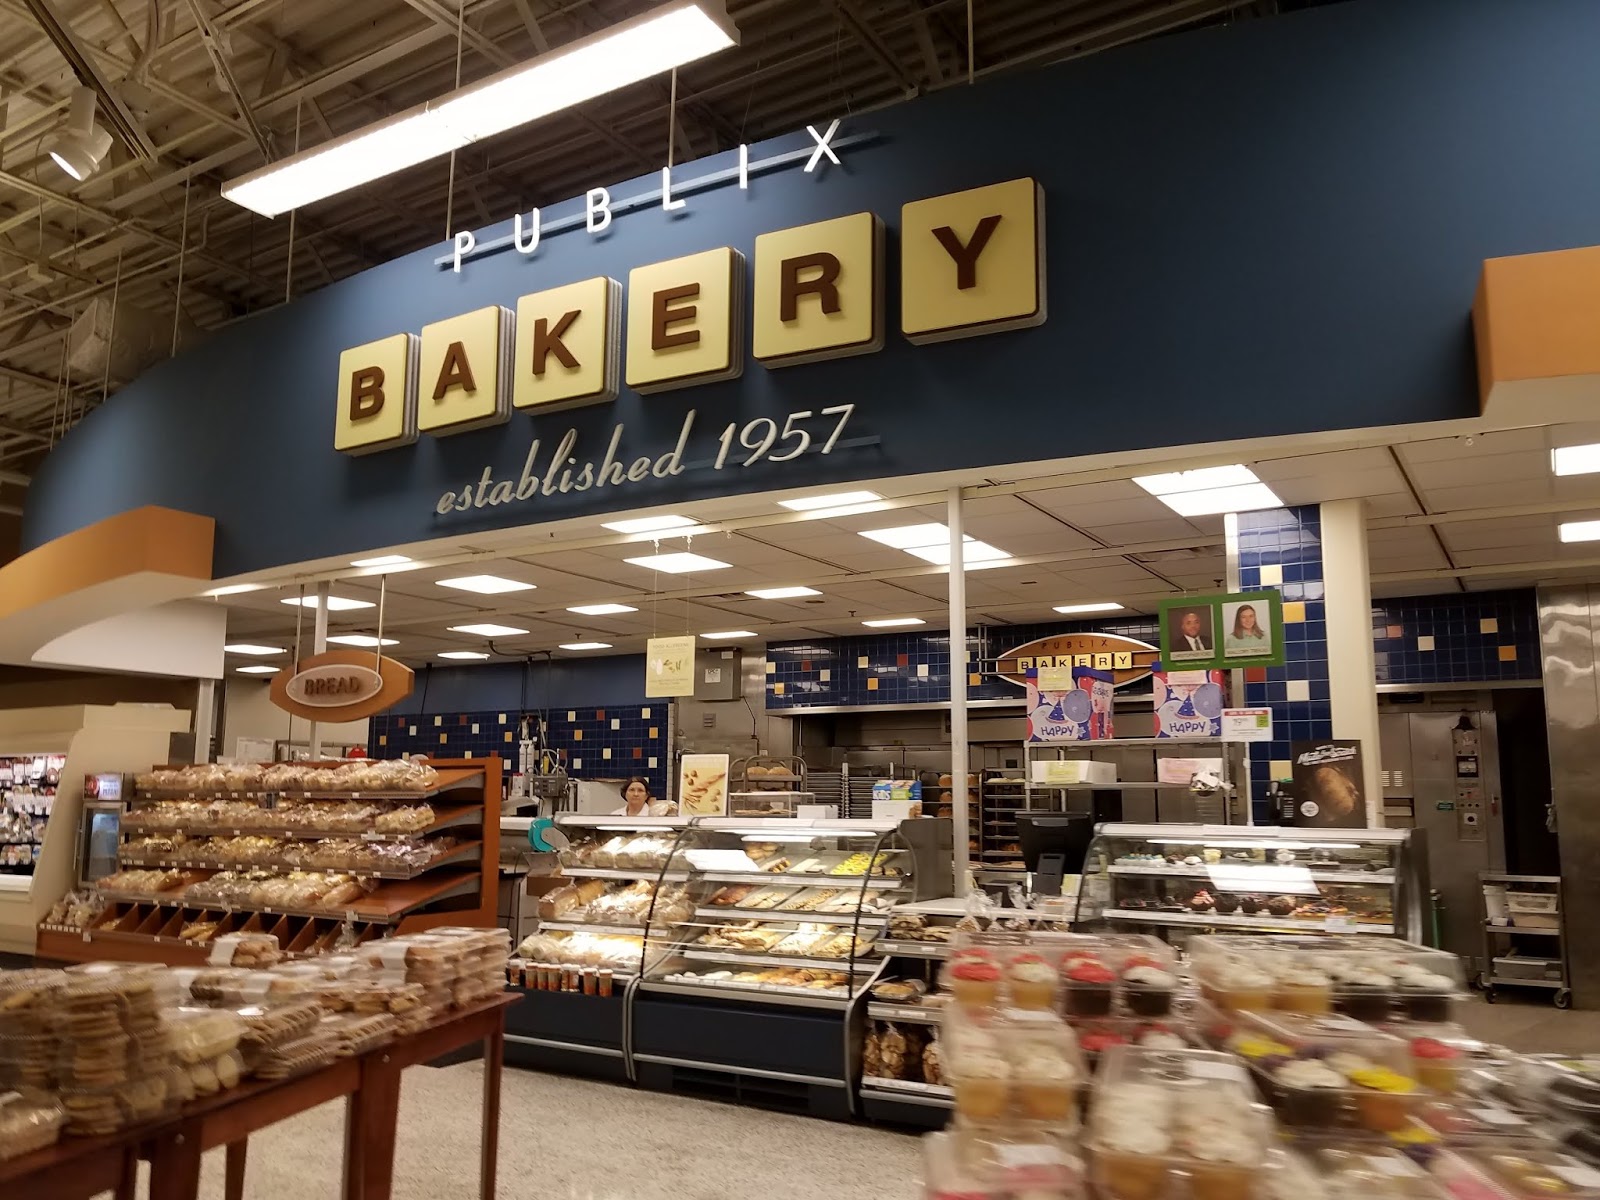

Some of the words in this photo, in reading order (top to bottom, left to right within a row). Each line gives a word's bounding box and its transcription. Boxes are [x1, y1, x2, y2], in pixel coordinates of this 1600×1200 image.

[453, 118, 842, 273] PUBLIX
[349, 213, 1004, 422] BAKERY
[435, 408, 698, 515] established
[712, 403, 856, 470] 1957
[1041, 639, 1108, 649] PUBLIX
[1020, 655, 1128, 670] BAKERY
[303, 676, 361, 697] BREAD
[1040, 724, 1075, 737] HAPPY
[1169, 720, 1207, 734] HAPPY
